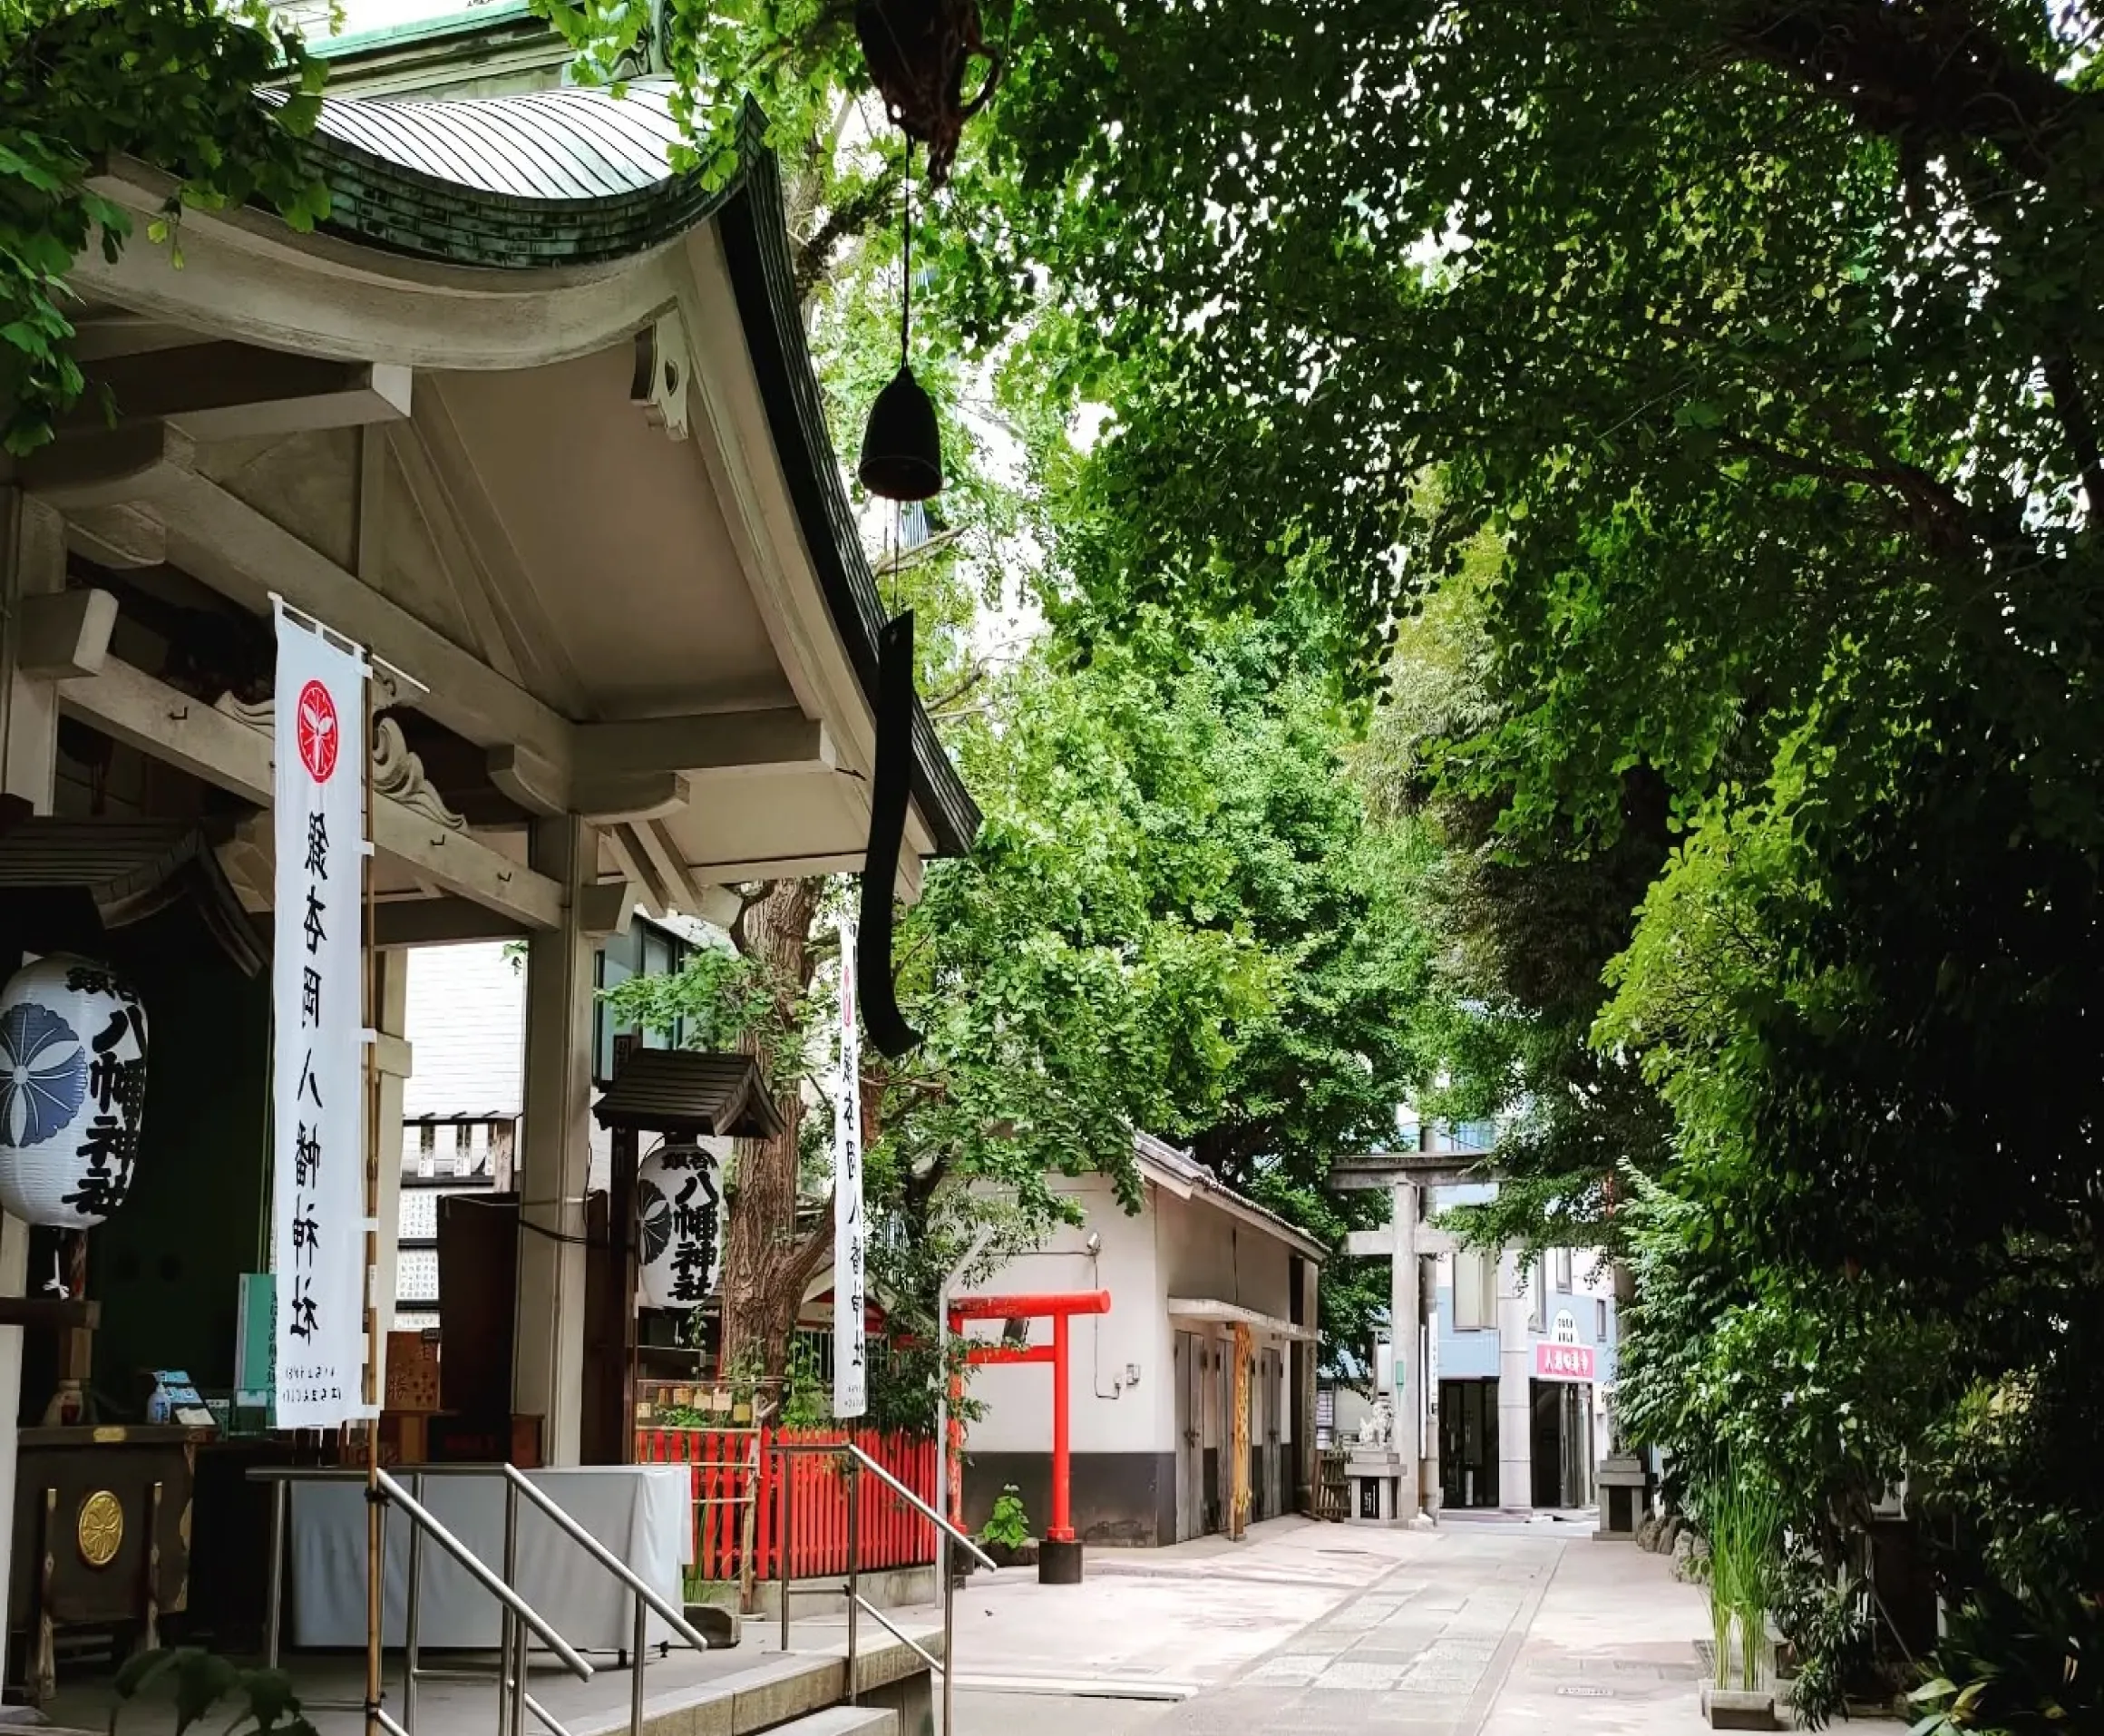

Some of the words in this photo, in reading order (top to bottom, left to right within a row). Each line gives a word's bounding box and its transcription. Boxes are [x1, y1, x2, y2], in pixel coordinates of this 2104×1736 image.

[62, 1004, 147, 1214] 八幡神社
[667, 1170, 719, 1300] 八幡神社
